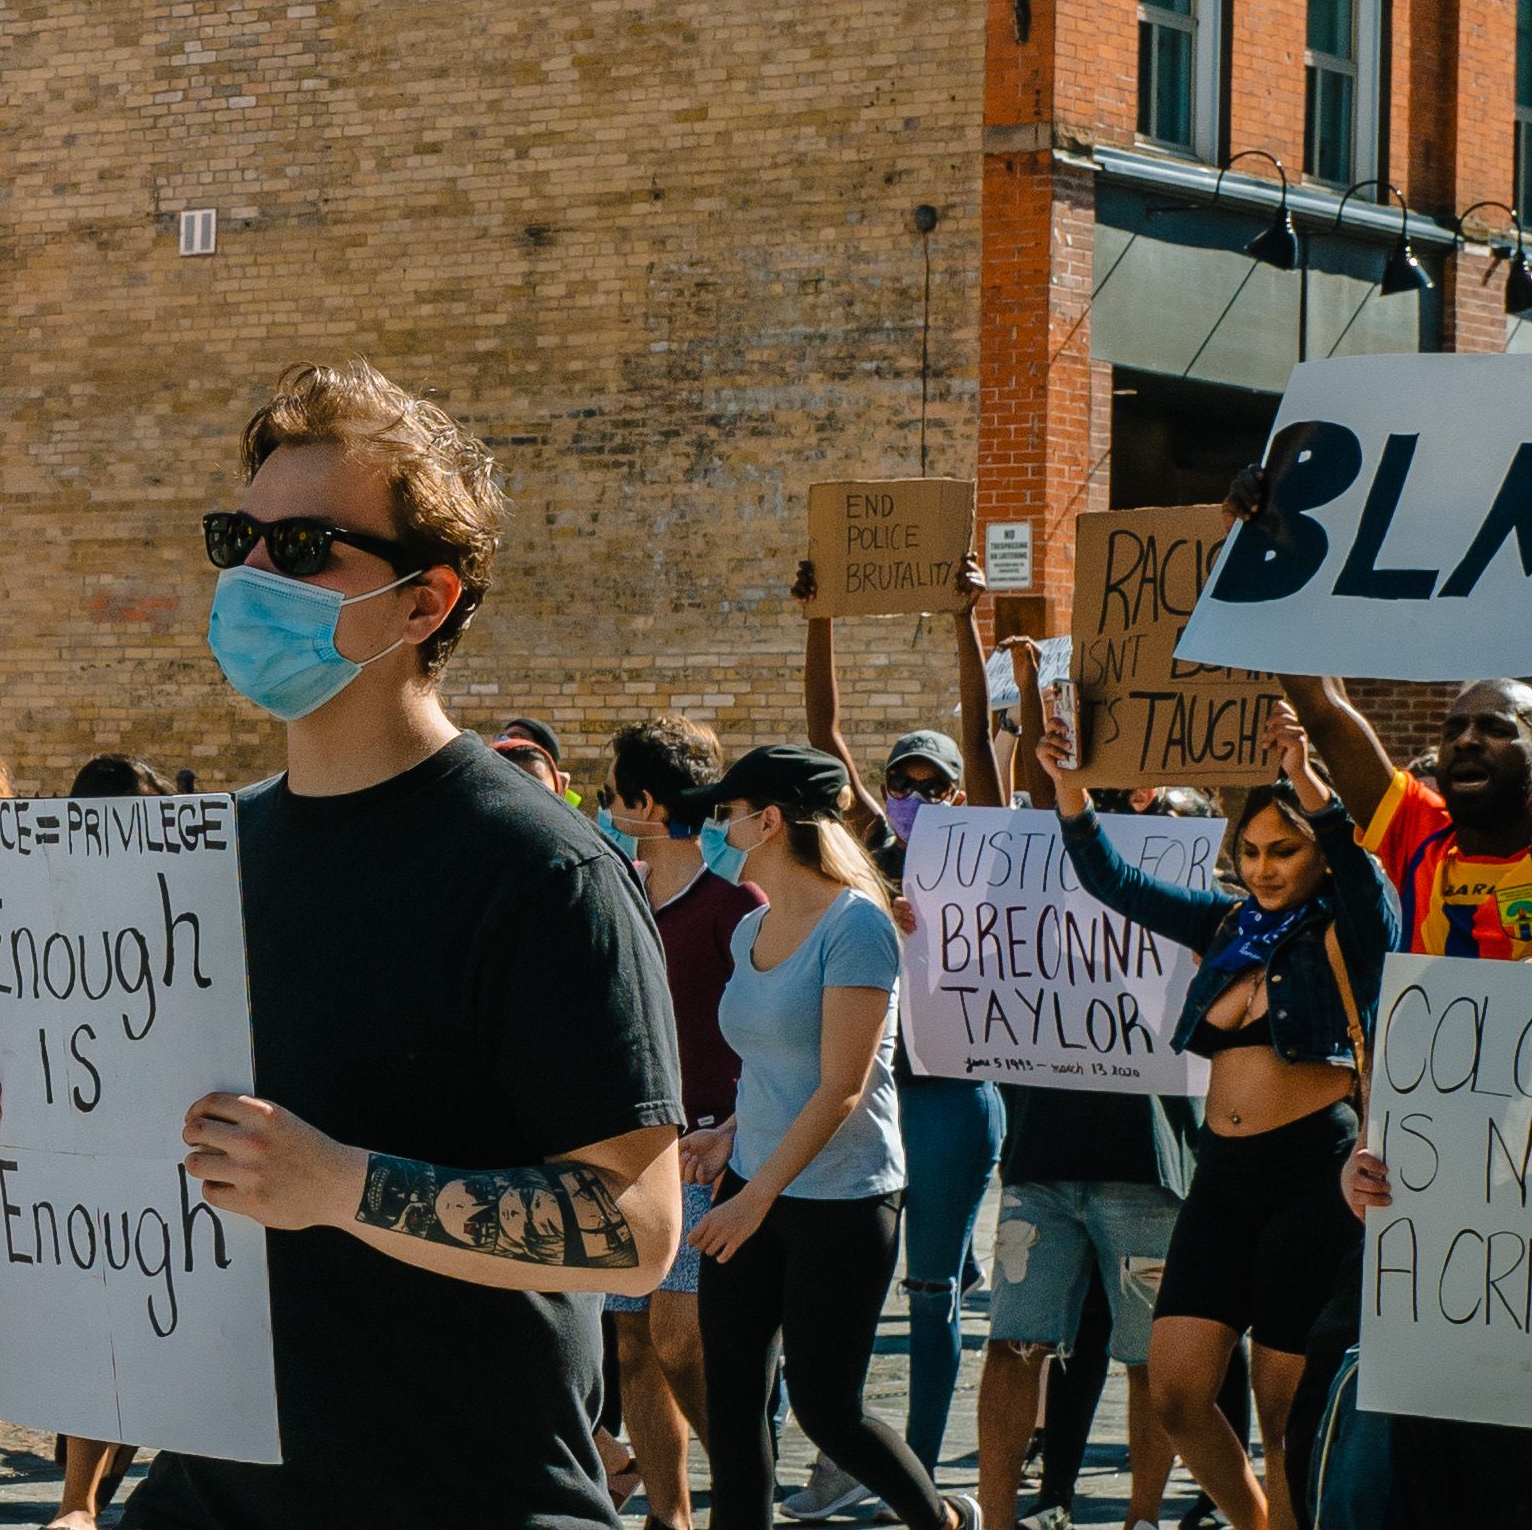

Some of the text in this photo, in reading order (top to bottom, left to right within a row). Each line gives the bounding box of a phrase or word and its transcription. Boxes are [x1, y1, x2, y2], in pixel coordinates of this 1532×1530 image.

[846, 494, 895, 519] END
[847, 523, 920, 555] POLICE
[846, 561, 953, 594] BRUTALITY
[1078, 634, 1148, 689] ISN'T
[1129, 691, 1284, 772] TAUGHT
[1138, 835, 1211, 890] FOR
[941, 902, 1162, 986] BREONNA
[940, 987, 1154, 1055] TAYLOR
[39, 1024, 101, 1113] IS
[993, 1057, 1002, 1068] 5
[1111, 1066, 1140, 1078] 2020
[1381, 1110, 1439, 1192] IS
[1376, 1217, 1418, 1322] A
